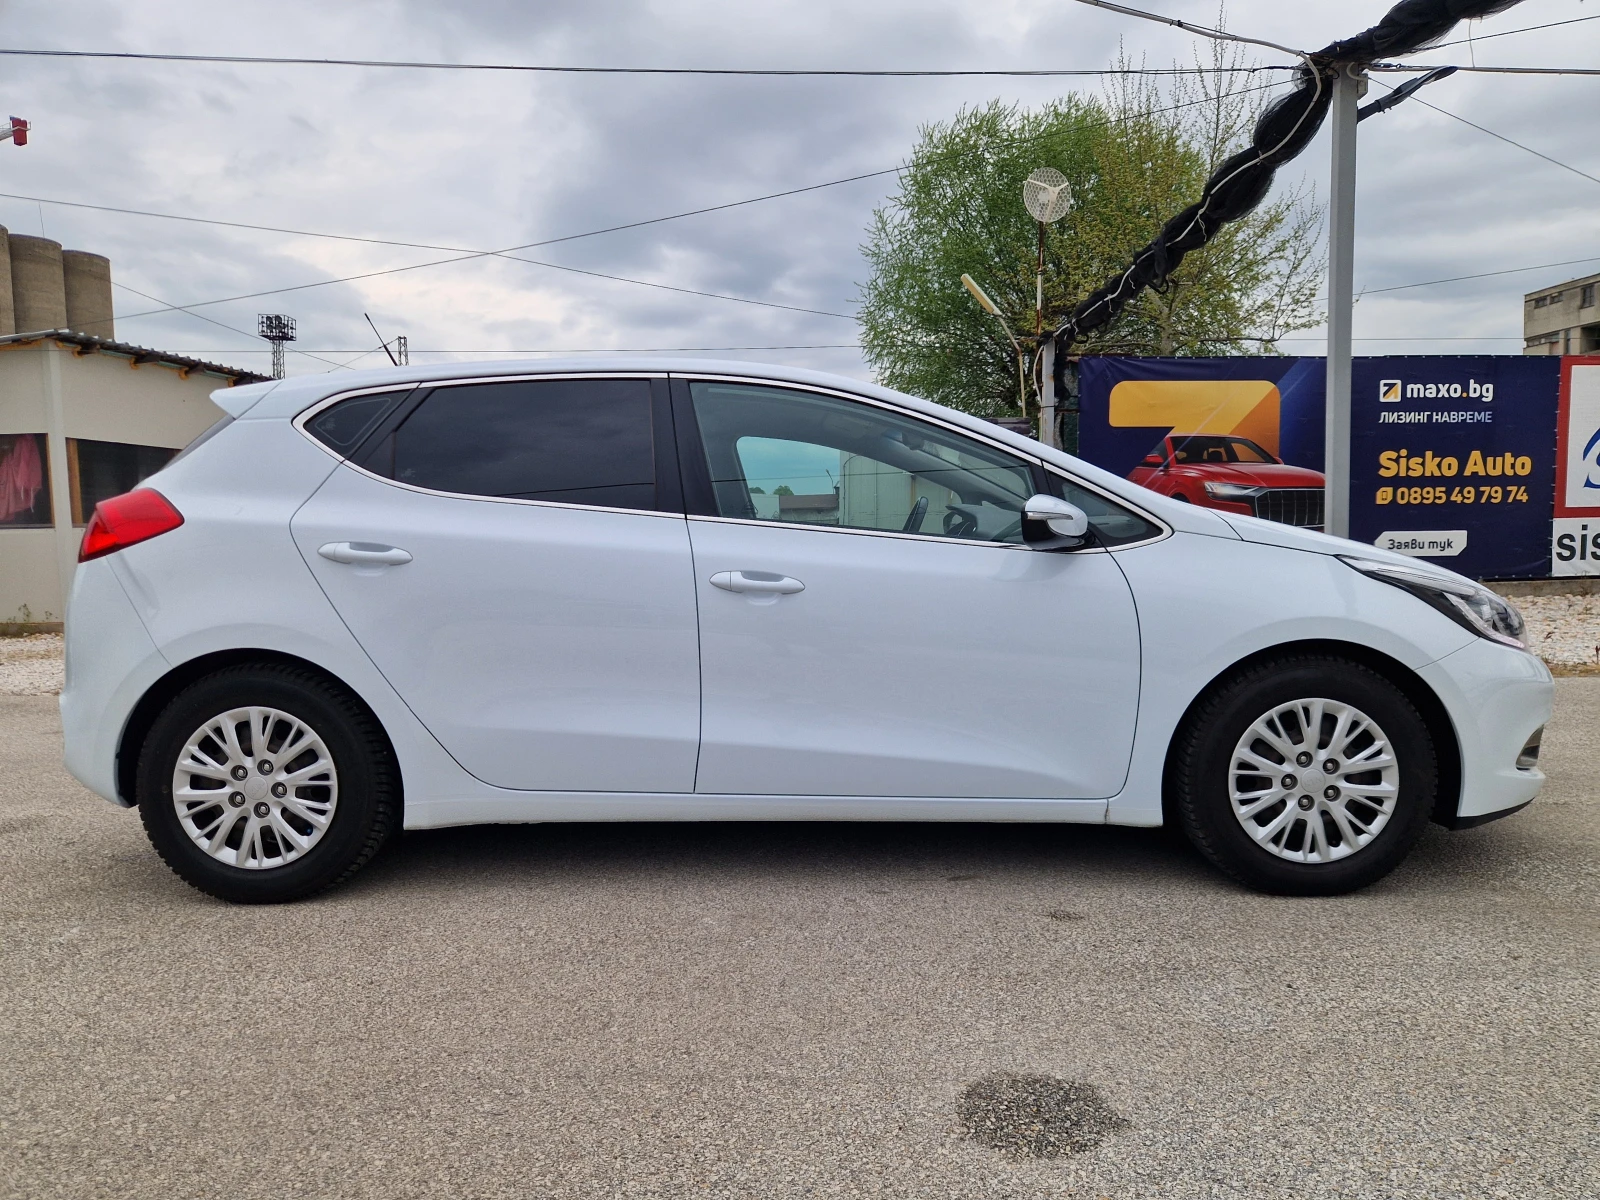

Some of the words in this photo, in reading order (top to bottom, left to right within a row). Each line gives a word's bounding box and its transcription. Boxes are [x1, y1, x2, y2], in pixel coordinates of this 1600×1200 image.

[1406, 378, 1494, 402] maxo.bg
[1378, 411, 1431, 424] ЛИЗИНГ
[1432, 411, 1493, 423] НАВРЕМЕ
[1377, 448, 1459, 478] Sisko
[1463, 450, 1532, 477] Auto
[1396, 486, 1447, 505] 0895
[1450, 486, 1475, 504] 49
[1479, 485, 1503, 504] 79
[1506, 485, 1528, 503] 74
[1387, 538, 1425, 550] Заяви
[1428, 538, 1453, 552] тук
